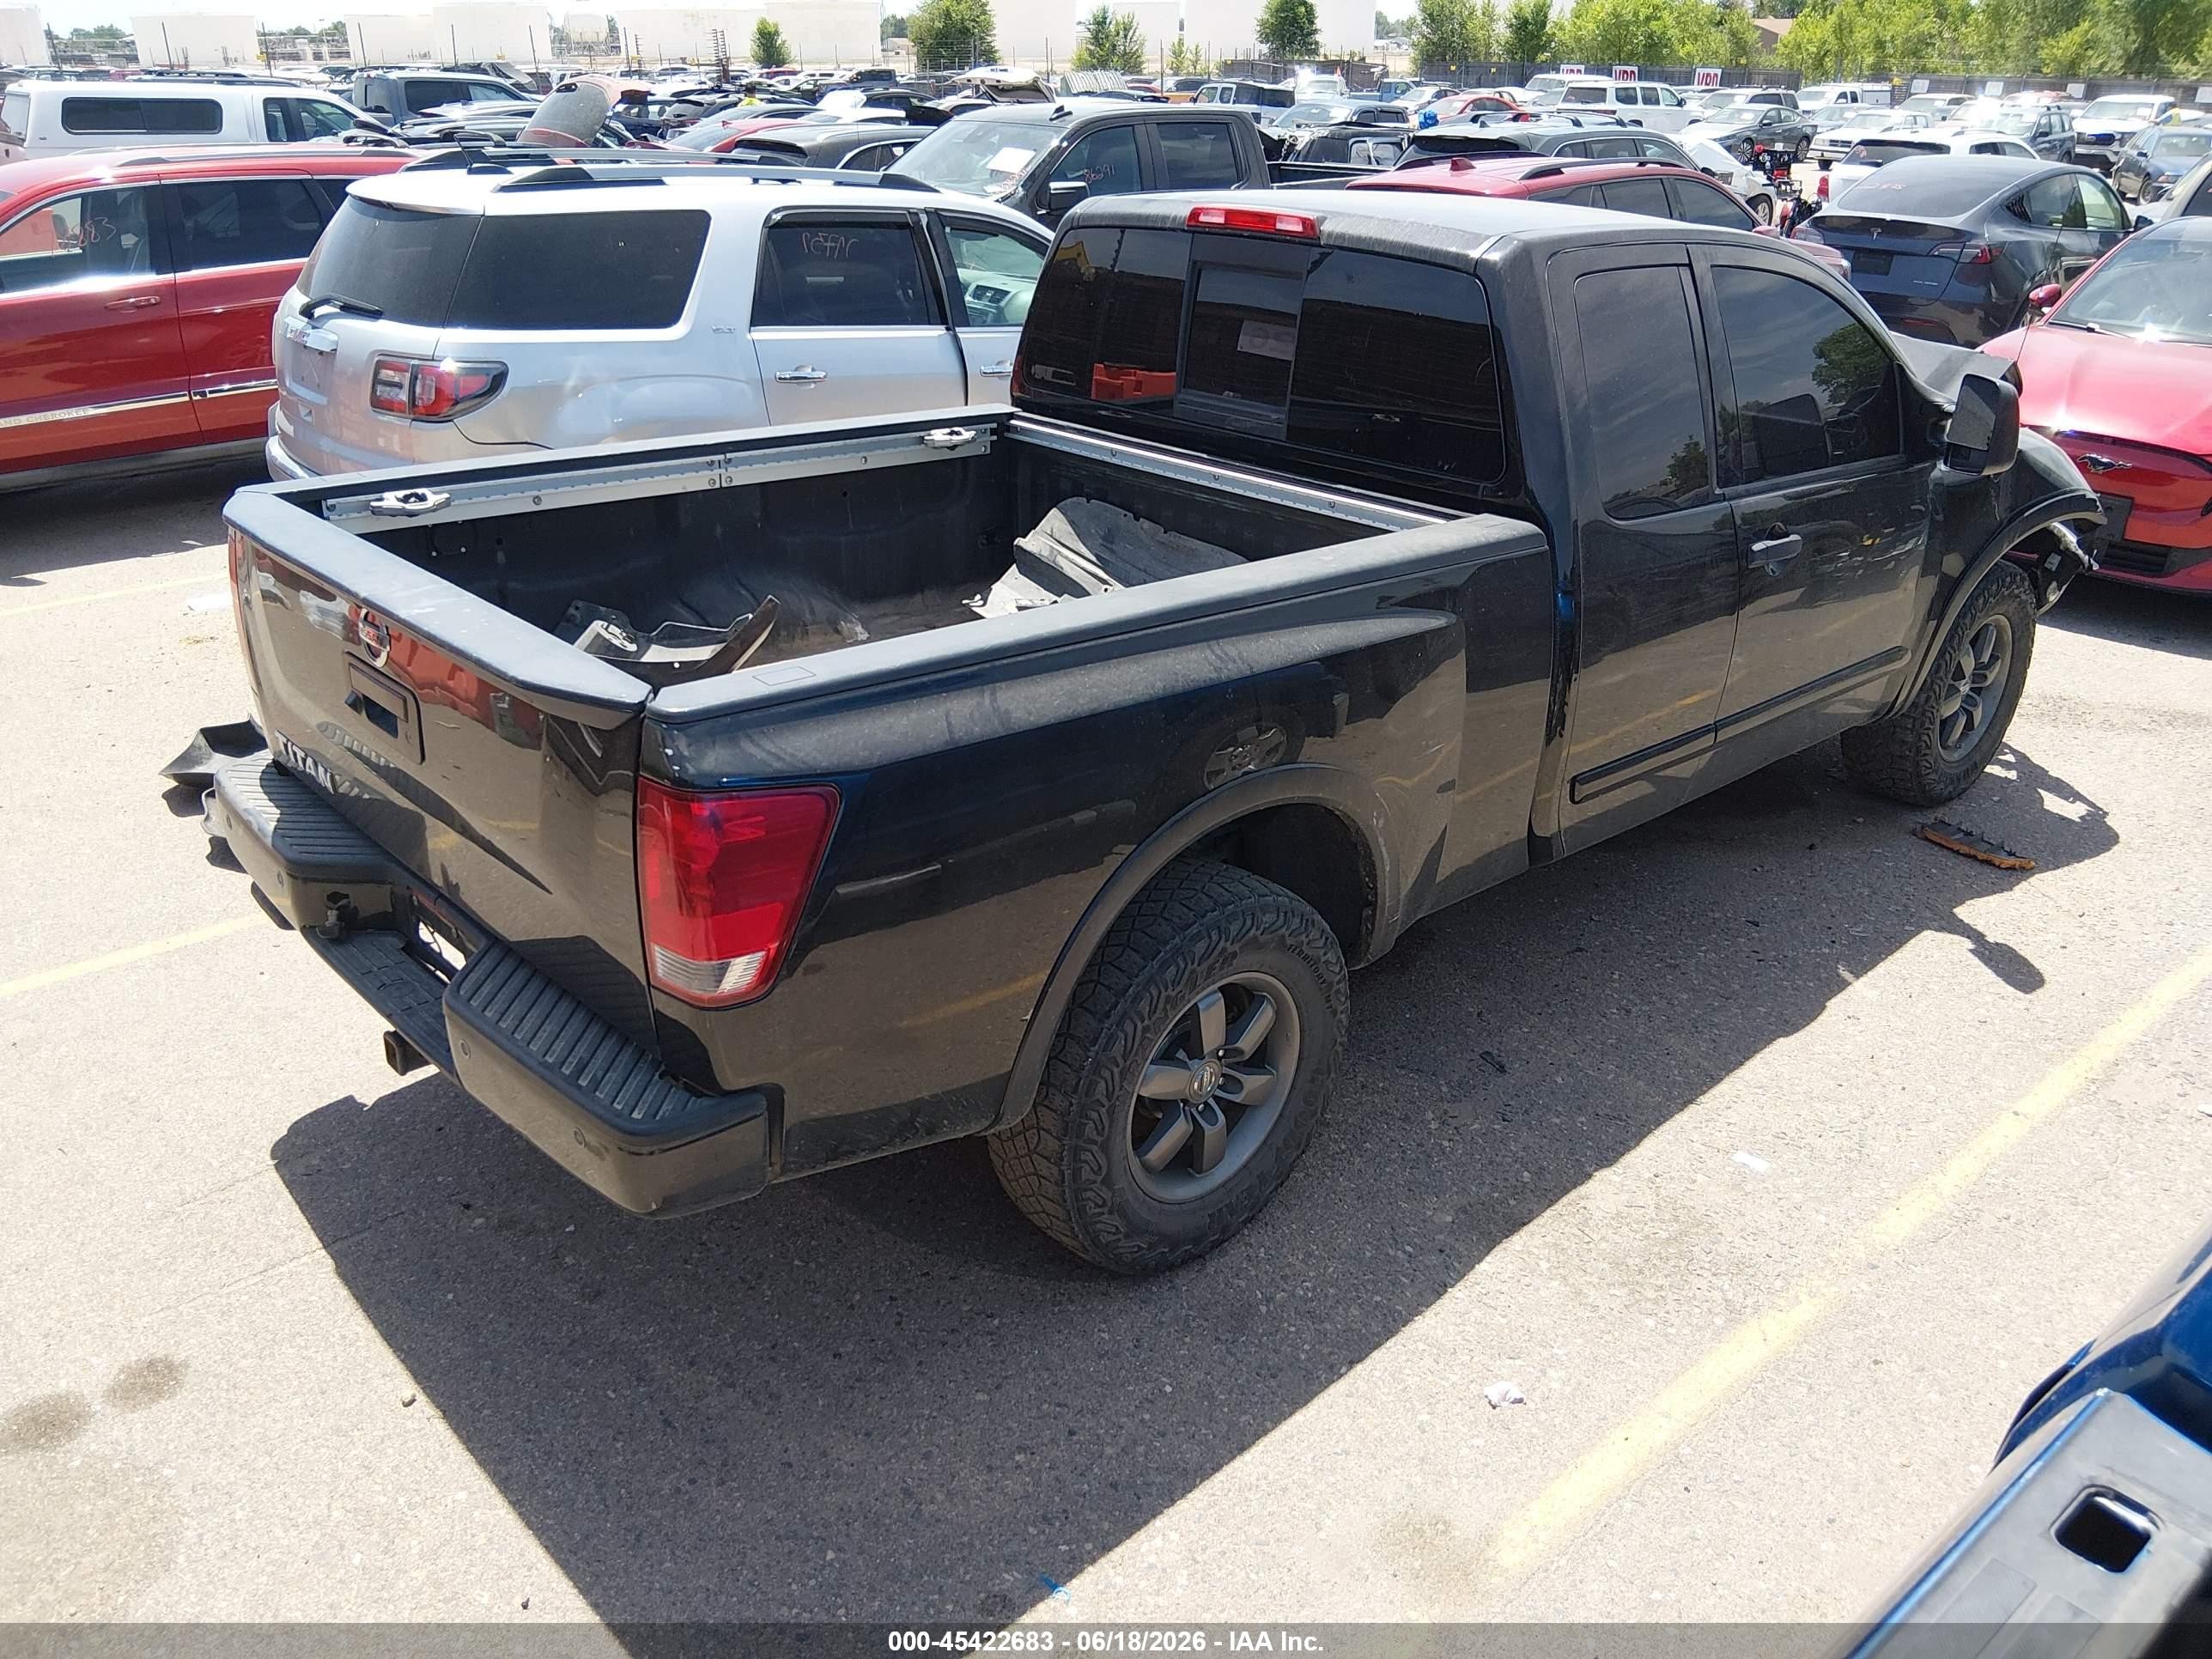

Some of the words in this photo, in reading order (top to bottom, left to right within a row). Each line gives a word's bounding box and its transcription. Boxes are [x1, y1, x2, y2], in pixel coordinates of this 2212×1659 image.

[27, 408, 90, 422] CHEROKEE
[274, 729, 337, 795] TITAN
[1286, 944, 1327, 985] TERRITORY
